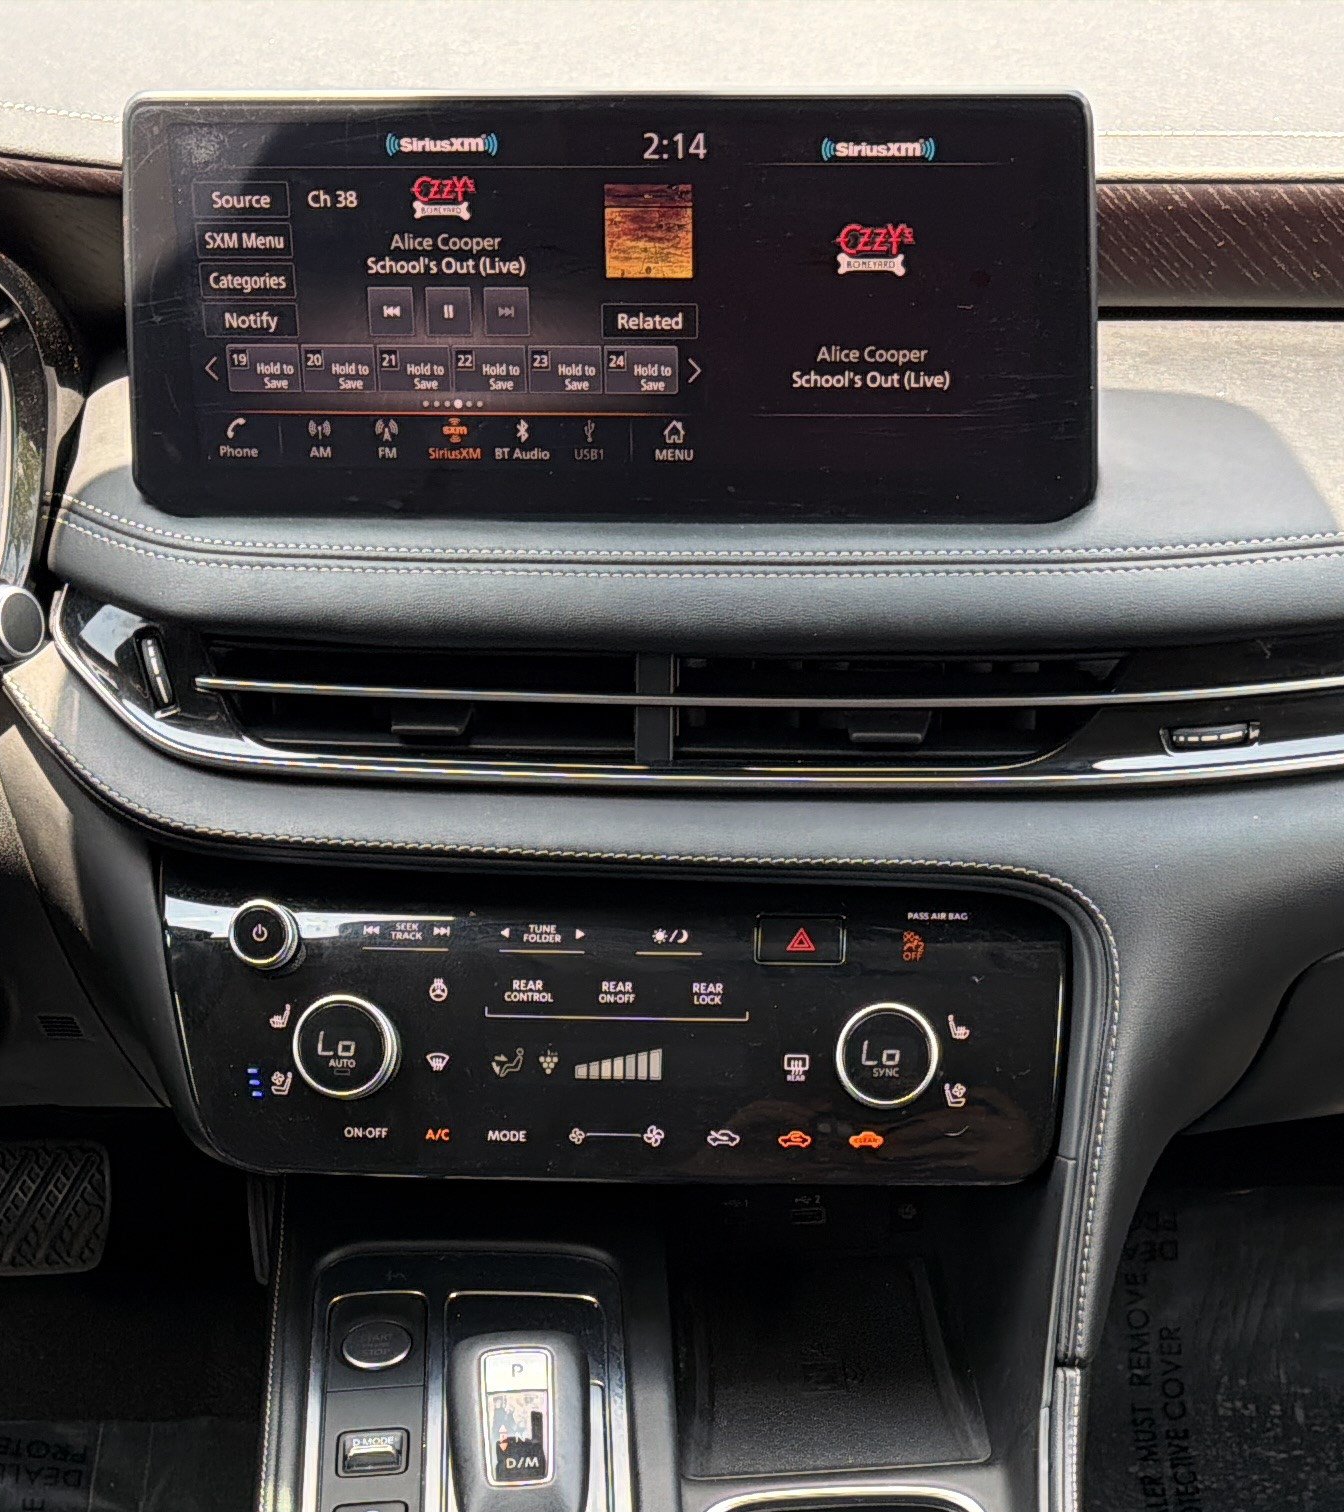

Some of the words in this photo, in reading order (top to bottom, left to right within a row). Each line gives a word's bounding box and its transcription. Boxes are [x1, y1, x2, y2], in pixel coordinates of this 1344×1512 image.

[642, 132, 708, 160] 2:14
[211, 191, 272, 208] Source
[307, 191, 330, 208] Ch
[335, 190, 358, 208] 38
[204, 232, 237, 249] SXM
[241, 232, 285, 250] Menu
[390, 234, 432, 250] Alice
[437, 234, 502, 255] Cooper
[367, 257, 438, 274] School's
[441, 257, 476, 274] Out
[479, 256, 527, 277] (Live)
[208, 271, 287, 292] Categories
[224, 312, 280, 332] Notify
[616, 312, 683, 330] Related
[232, 352, 248, 367] 19
[306, 352, 323, 367] 20
[382, 352, 398, 367] 21
[457, 353, 474, 368] 22
[533, 353, 549, 368] 23
[608, 353, 625, 368] 24
[816, 346, 859, 363] Alice
[864, 347, 928, 367] Cooper
[257, 362, 281, 376] Hold
[283, 363, 294, 376] to
[331, 362, 356, 376] Hold
[358, 363, 370, 376] to
[407, 362, 432, 376] Hold
[433, 363, 445, 376] to
[482, 362, 507, 376] Hold
[509, 363, 520, 376] to
[558, 362, 583, 376] Hold
[584, 363, 596, 376] to
[633, 362, 658, 376] Hold
[660, 363, 672, 376] to
[264, 377, 289, 391] Save
[338, 377, 364, 391] Save
[414, 377, 439, 391] Save
[489, 377, 515, 391] Save
[564, 377, 590, 391] Save
[640, 377, 666, 391] Save
[792, 372, 863, 389] School's
[866, 372, 901, 389] Out
[904, 371, 951, 391] (Live)
[218, 444, 259, 459] Phone
[309, 445, 332, 458] AM
[377, 446, 397, 459] FM
[428, 446, 482, 460] SiriusXM
[494, 447, 512, 460] BT
[514, 447, 551, 460] Audio
[573, 447, 606, 461] USB1
[655, 448, 694, 461] MENU
[907, 911, 930, 921] PASS
[931, 911, 947, 921] AIR
[948, 911, 969, 921] BAG
[395, 922, 420, 931] SEEK
[528, 924, 558, 934] TUNE
[390, 930, 423, 941] TRACK
[522, 933, 562, 943] FOLDER
[512, 980, 544, 991] REAR
[601, 981, 634, 993] REAR
[692, 983, 724, 994] REAR
[504, 991, 554, 1003] CONTROL
[693, 994, 722, 1005] LOCK
[317, 1030, 357, 1057] Lo
[860, 1039, 901, 1066] Lo
[328, 1058, 357, 1069] AUTO
[872, 1067, 901, 1078] SYNC
[425, 1129, 451, 1142] A/C
[487, 1129, 528, 1142] MODE
[1123, 1270, 1152, 1388] REMOVE
[511, 1363, 524, 1378] P
[1159, 1325, 1187, 1421] COVER
[1130, 1403, 1159, 1463] MUST
[505, 1456, 540, 1470] D/M
